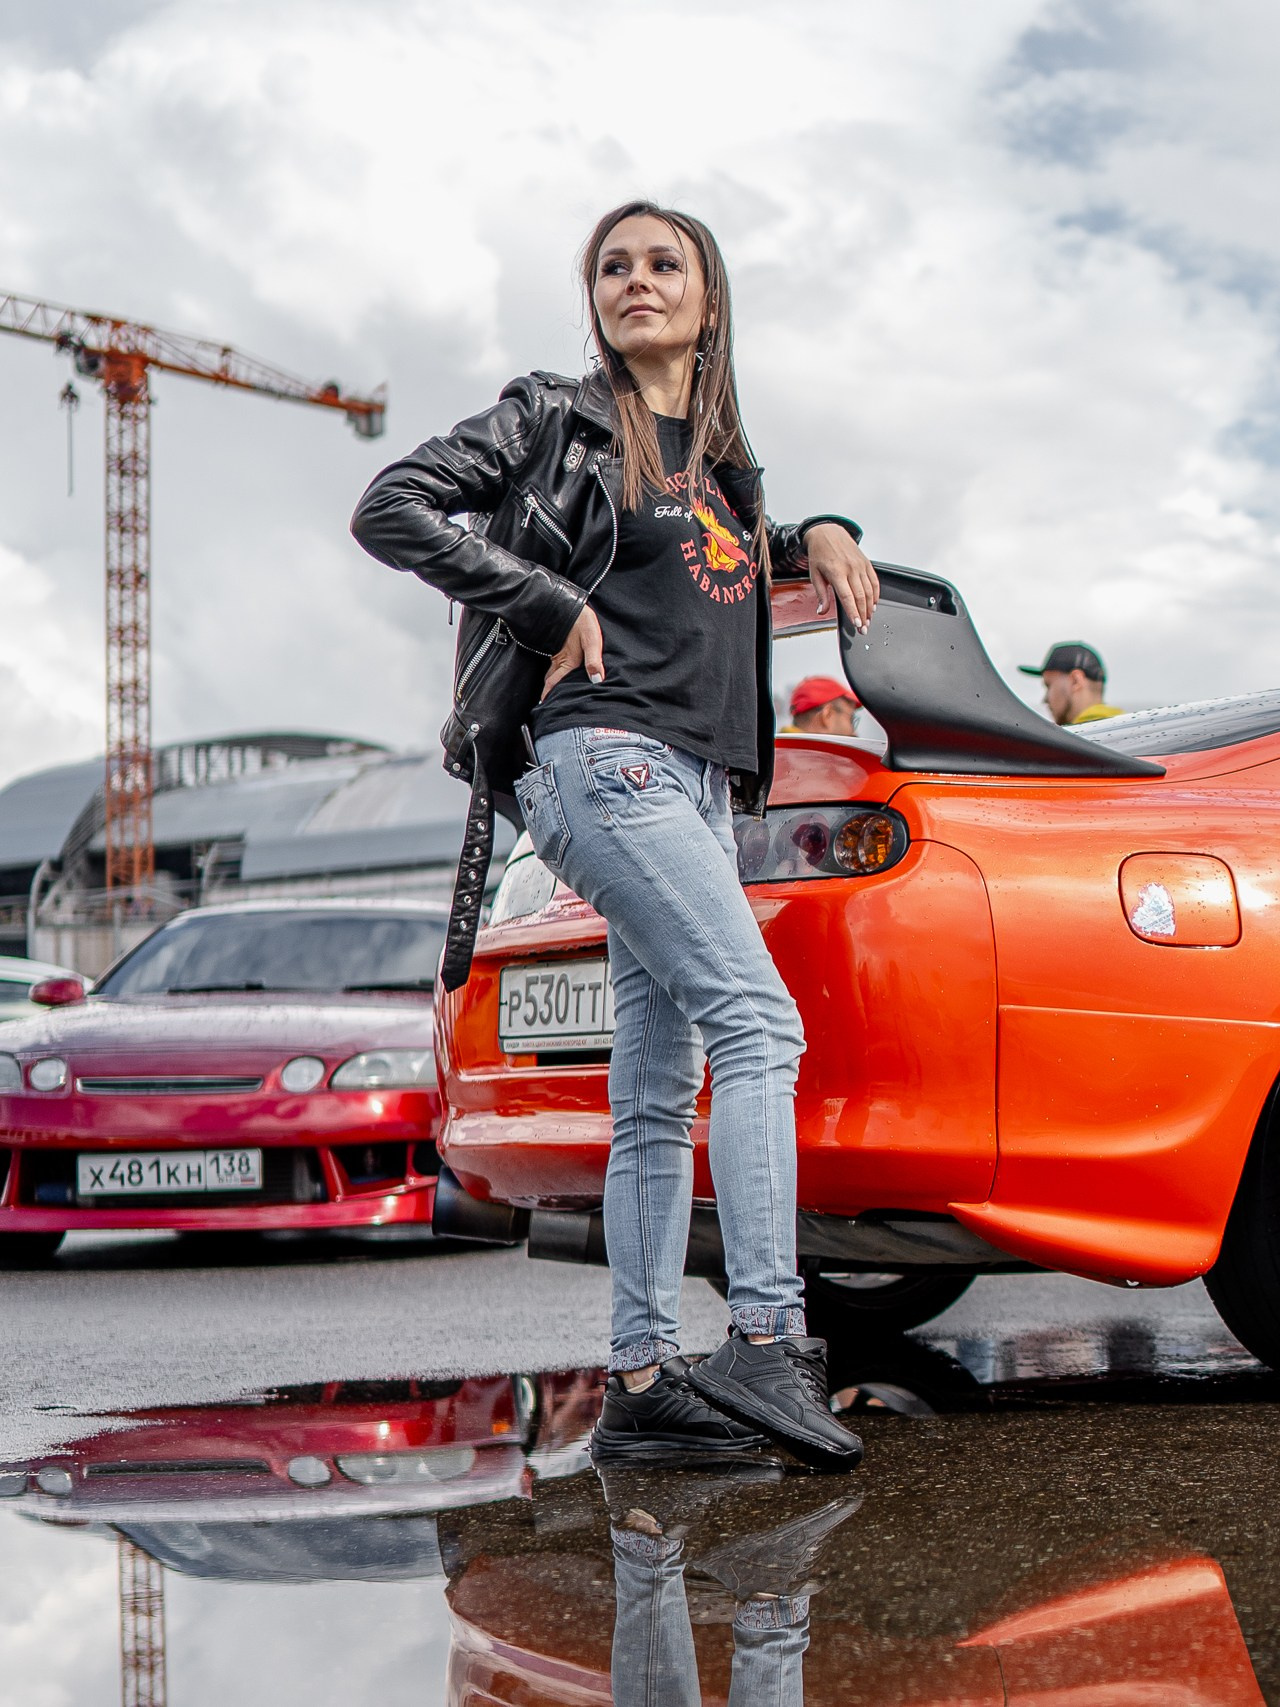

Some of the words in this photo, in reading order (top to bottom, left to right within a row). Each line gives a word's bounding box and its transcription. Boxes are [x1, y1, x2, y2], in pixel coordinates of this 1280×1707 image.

[654, 505, 682, 518] Full
[684, 510, 693, 522] of
[680, 538, 758, 604] HABANERO
[210, 1153, 251, 1175] 138
